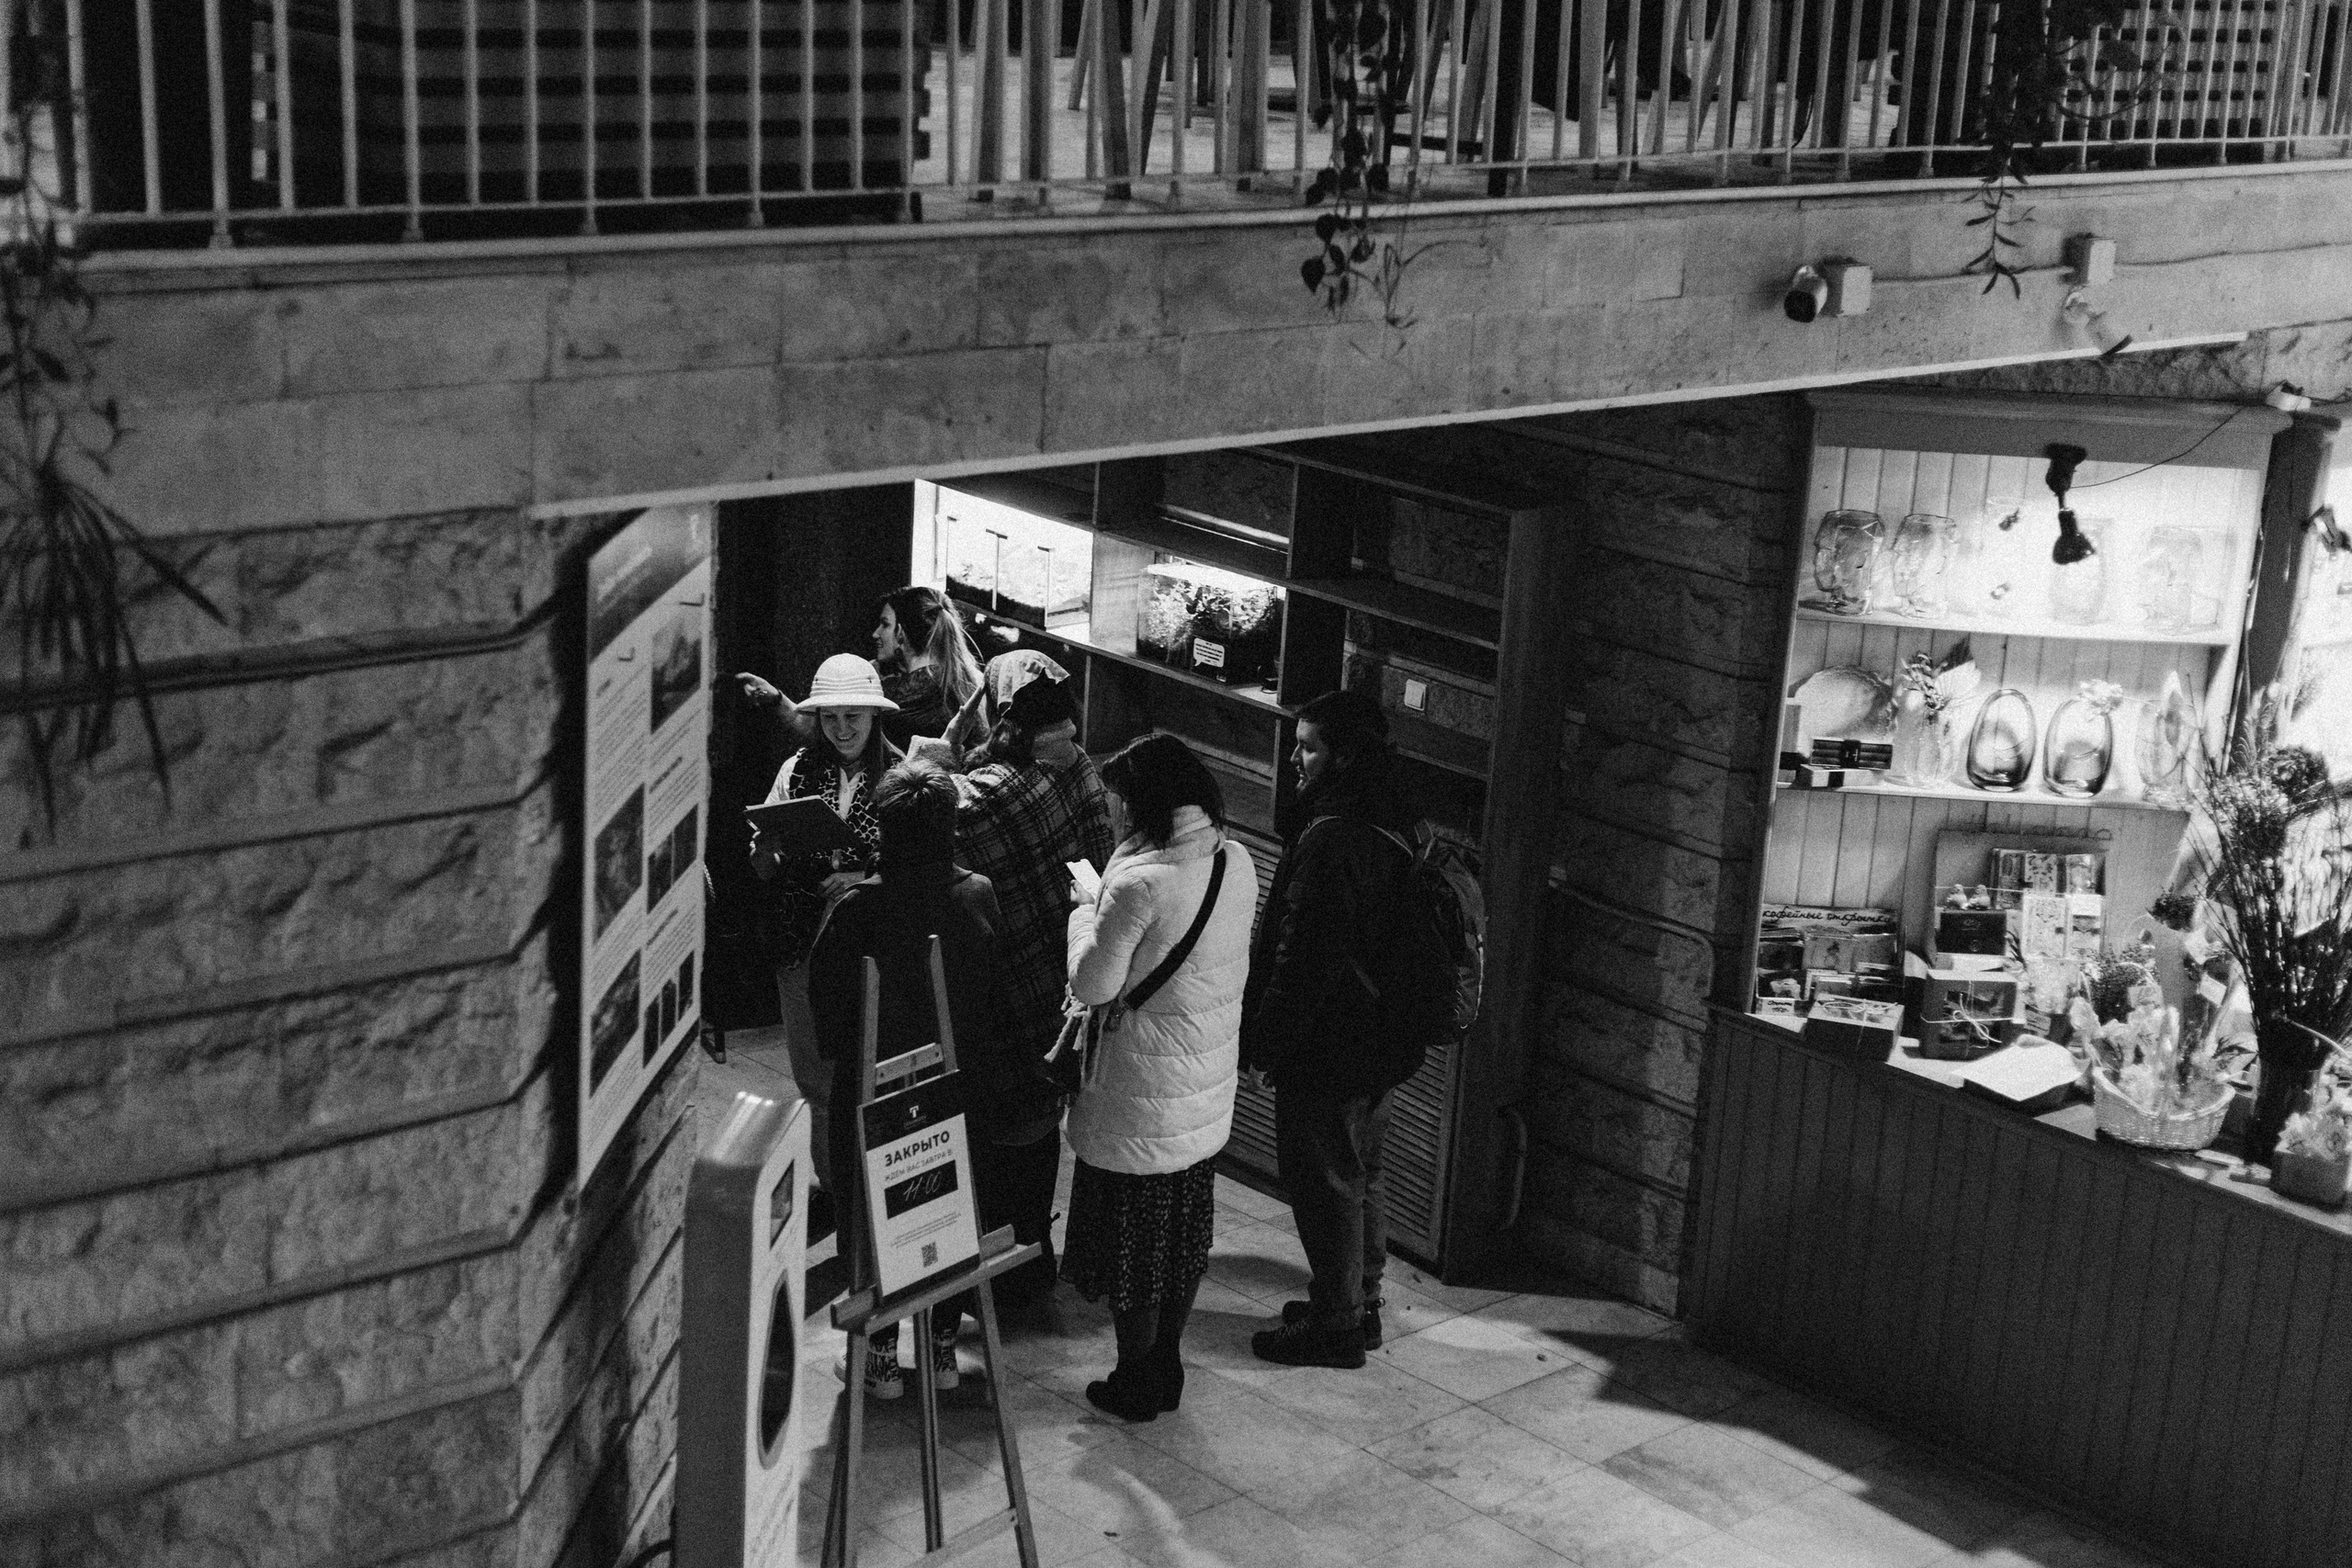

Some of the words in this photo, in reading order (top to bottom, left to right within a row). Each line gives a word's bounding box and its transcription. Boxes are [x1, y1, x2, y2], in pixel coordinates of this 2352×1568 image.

[885, 1130, 950, 1168] ЗАКРЫТО
[907, 1161, 922, 1174] ВАС
[922, 1152, 946, 1168] ЗАВТРА
